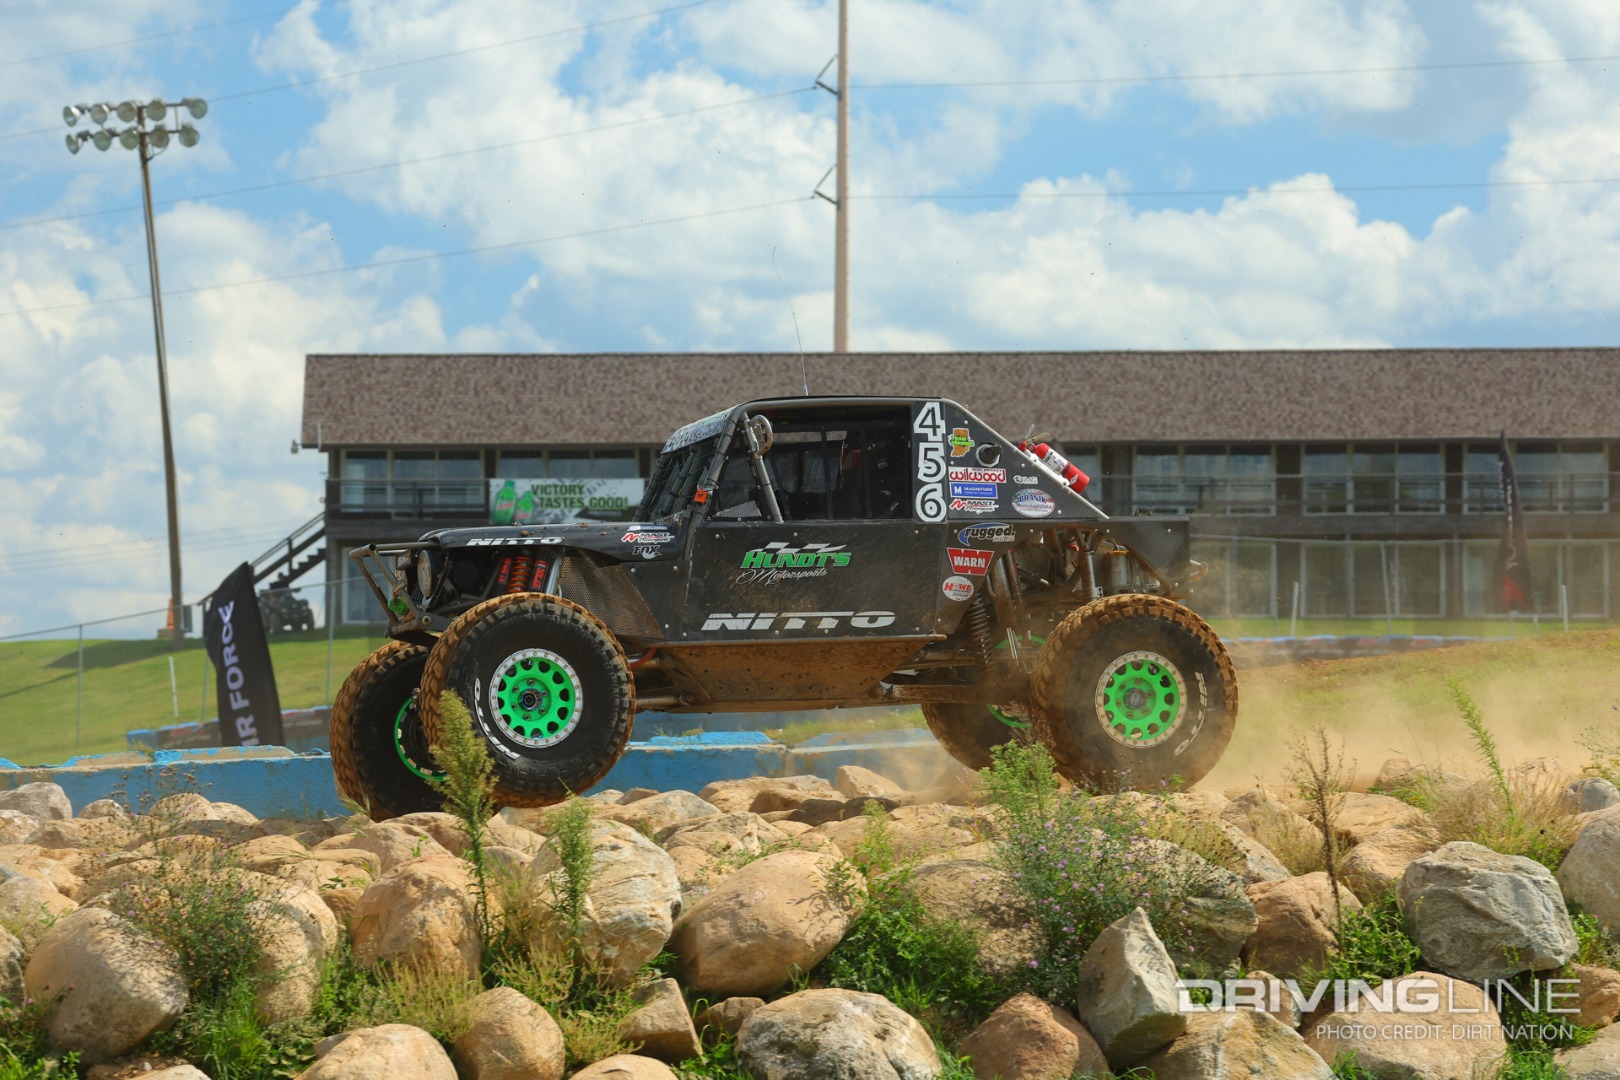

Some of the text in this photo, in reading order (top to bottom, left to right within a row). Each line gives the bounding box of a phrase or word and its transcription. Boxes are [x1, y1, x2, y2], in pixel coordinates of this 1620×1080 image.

[913, 401, 947, 522] 456
[949, 468, 1006, 483] wilwood
[531, 484, 585, 496] VICTORY
[539, 497, 628, 509] TASTES GOOD!
[466, 537, 563, 546] NITTO
[632, 545, 661, 556] FOX
[740, 551, 852, 569] HUNDT'S
[953, 556, 986, 568] WARN
[736, 567, 828, 586] Motorsports
[700, 610, 896, 631] NITTO
[218, 601, 260, 747] IR FORCE
